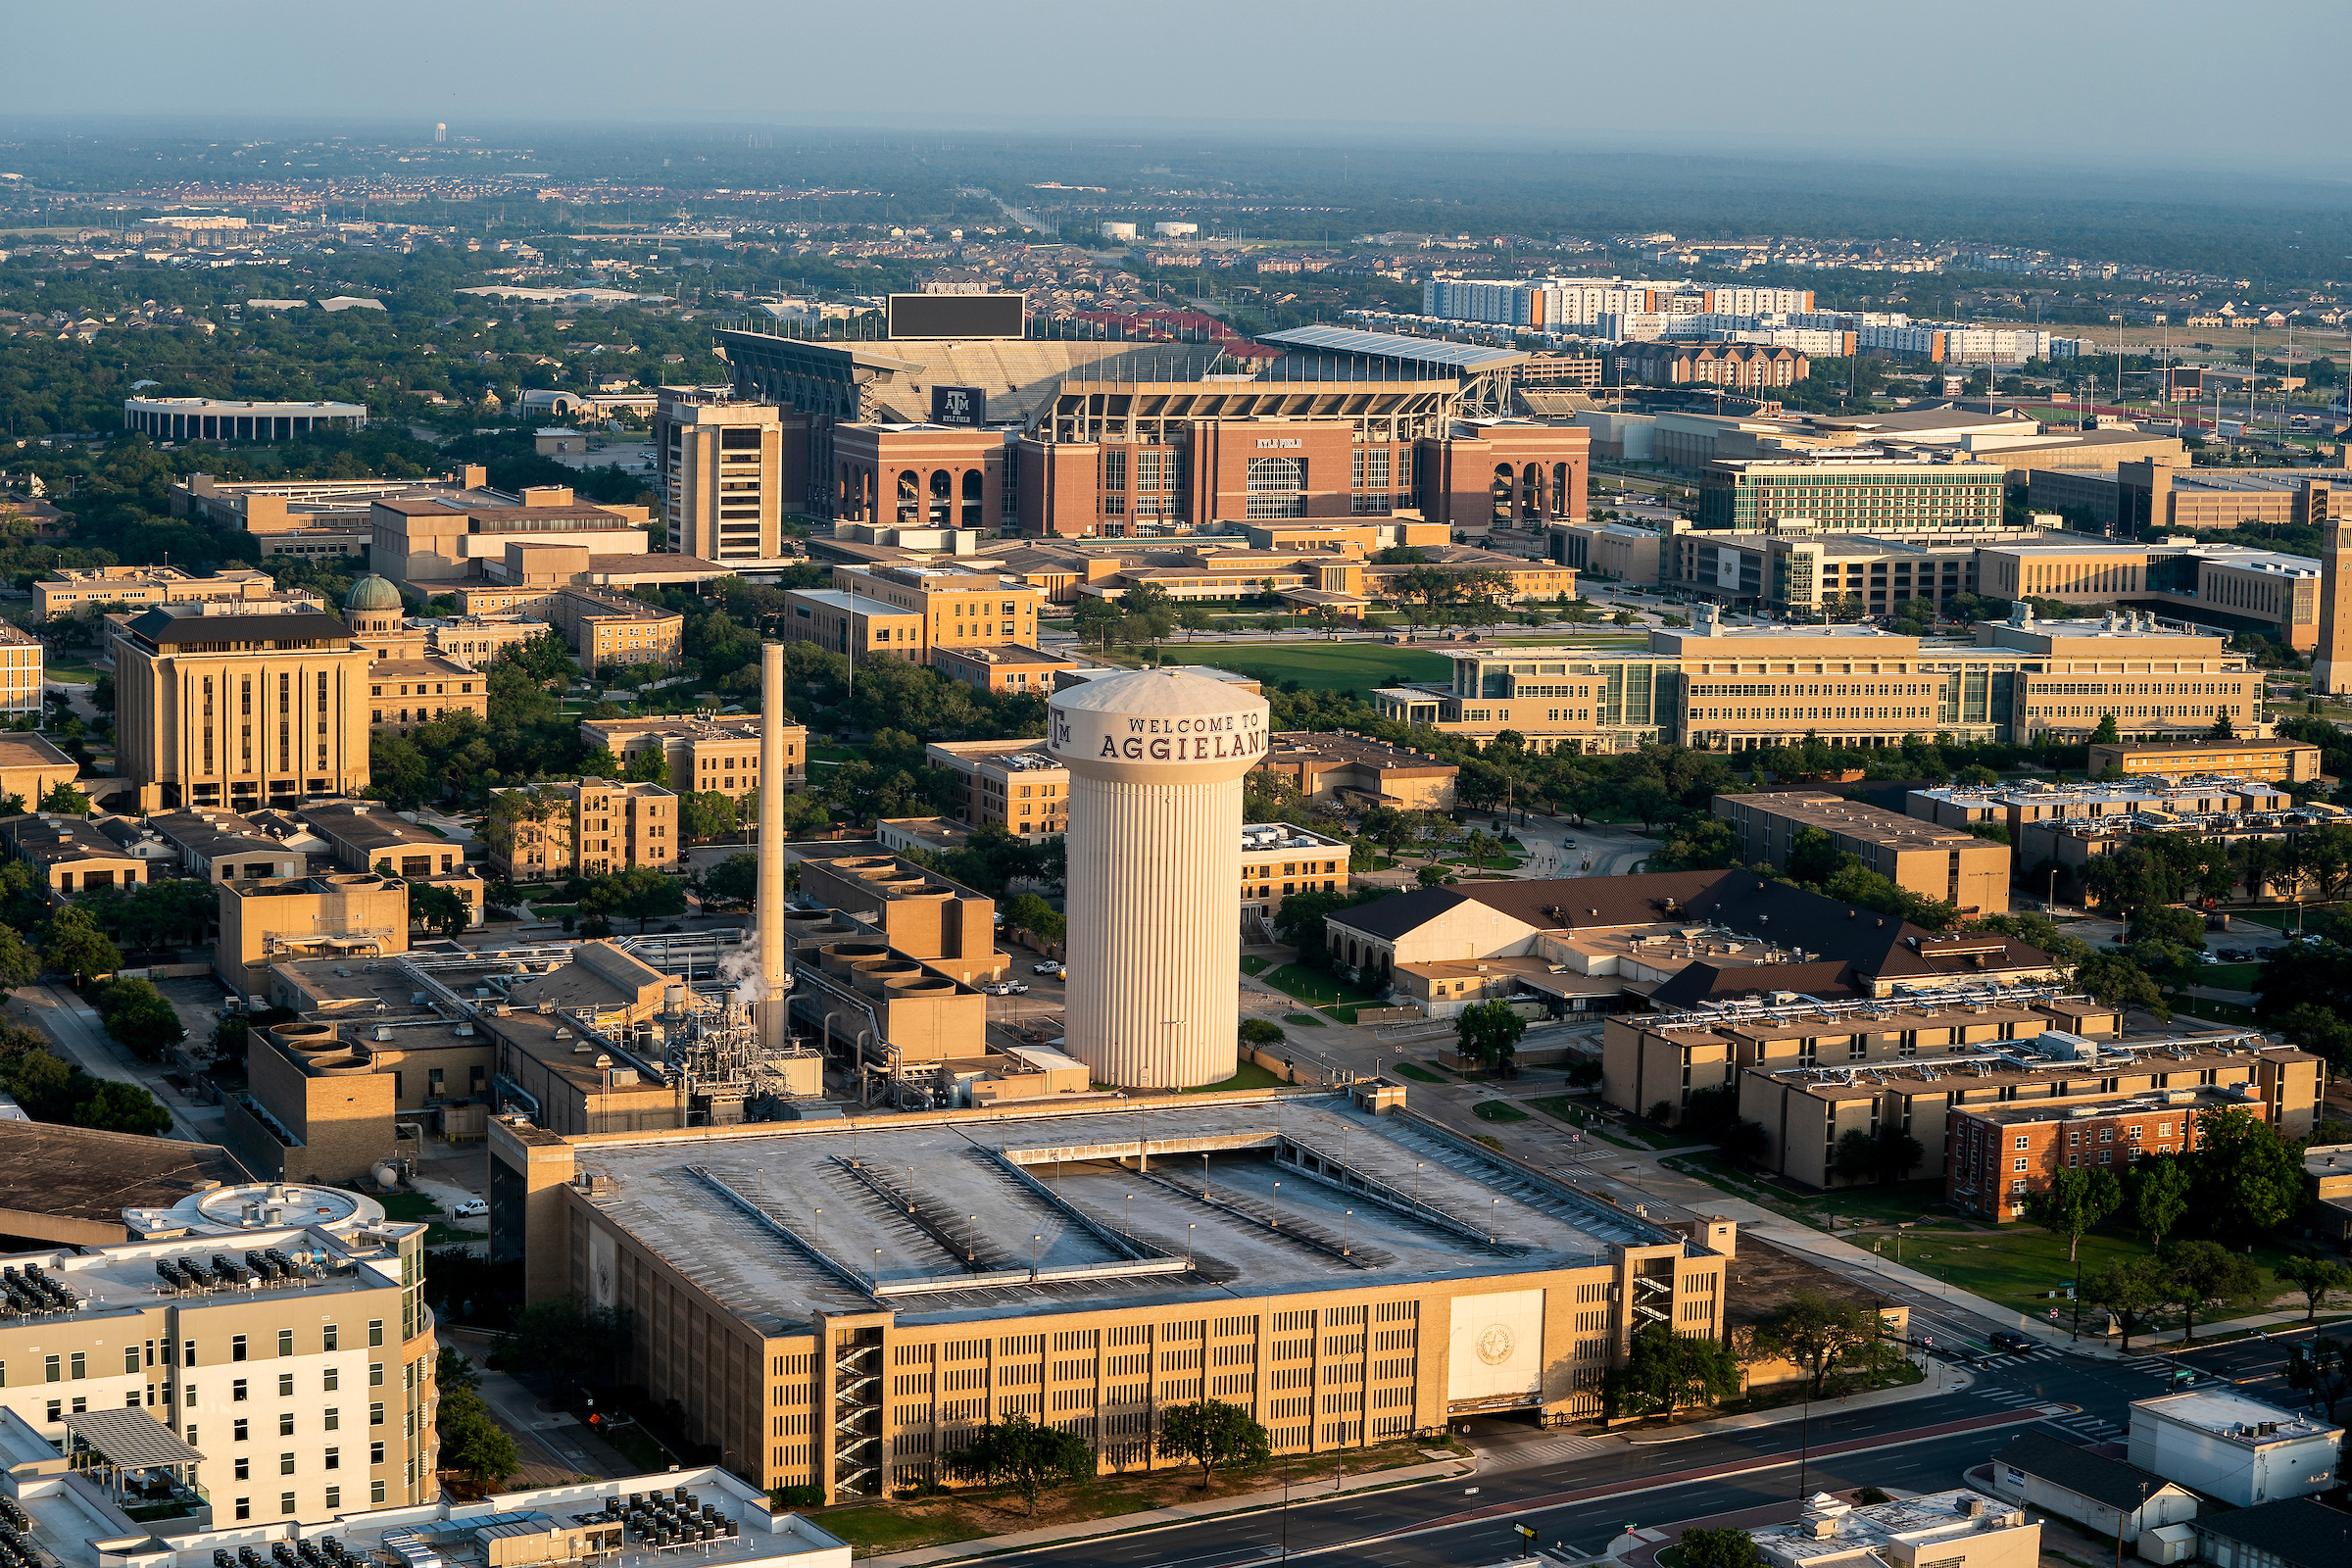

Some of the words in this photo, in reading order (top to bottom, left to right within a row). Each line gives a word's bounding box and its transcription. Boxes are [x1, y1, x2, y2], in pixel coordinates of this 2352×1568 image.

[928, 283, 955, 294] KYLE
[958, 283, 988, 294] FIELD
[1256, 439, 1278, 449] KYLE
[1279, 439, 1301, 449] FIELD
[1128, 715, 1234, 734] WELCOME
[1242, 711, 1258, 729] TO
[1099, 728, 1269, 761] AGGIELAND
[1514, 1523, 1536, 1538] SUBWAY
